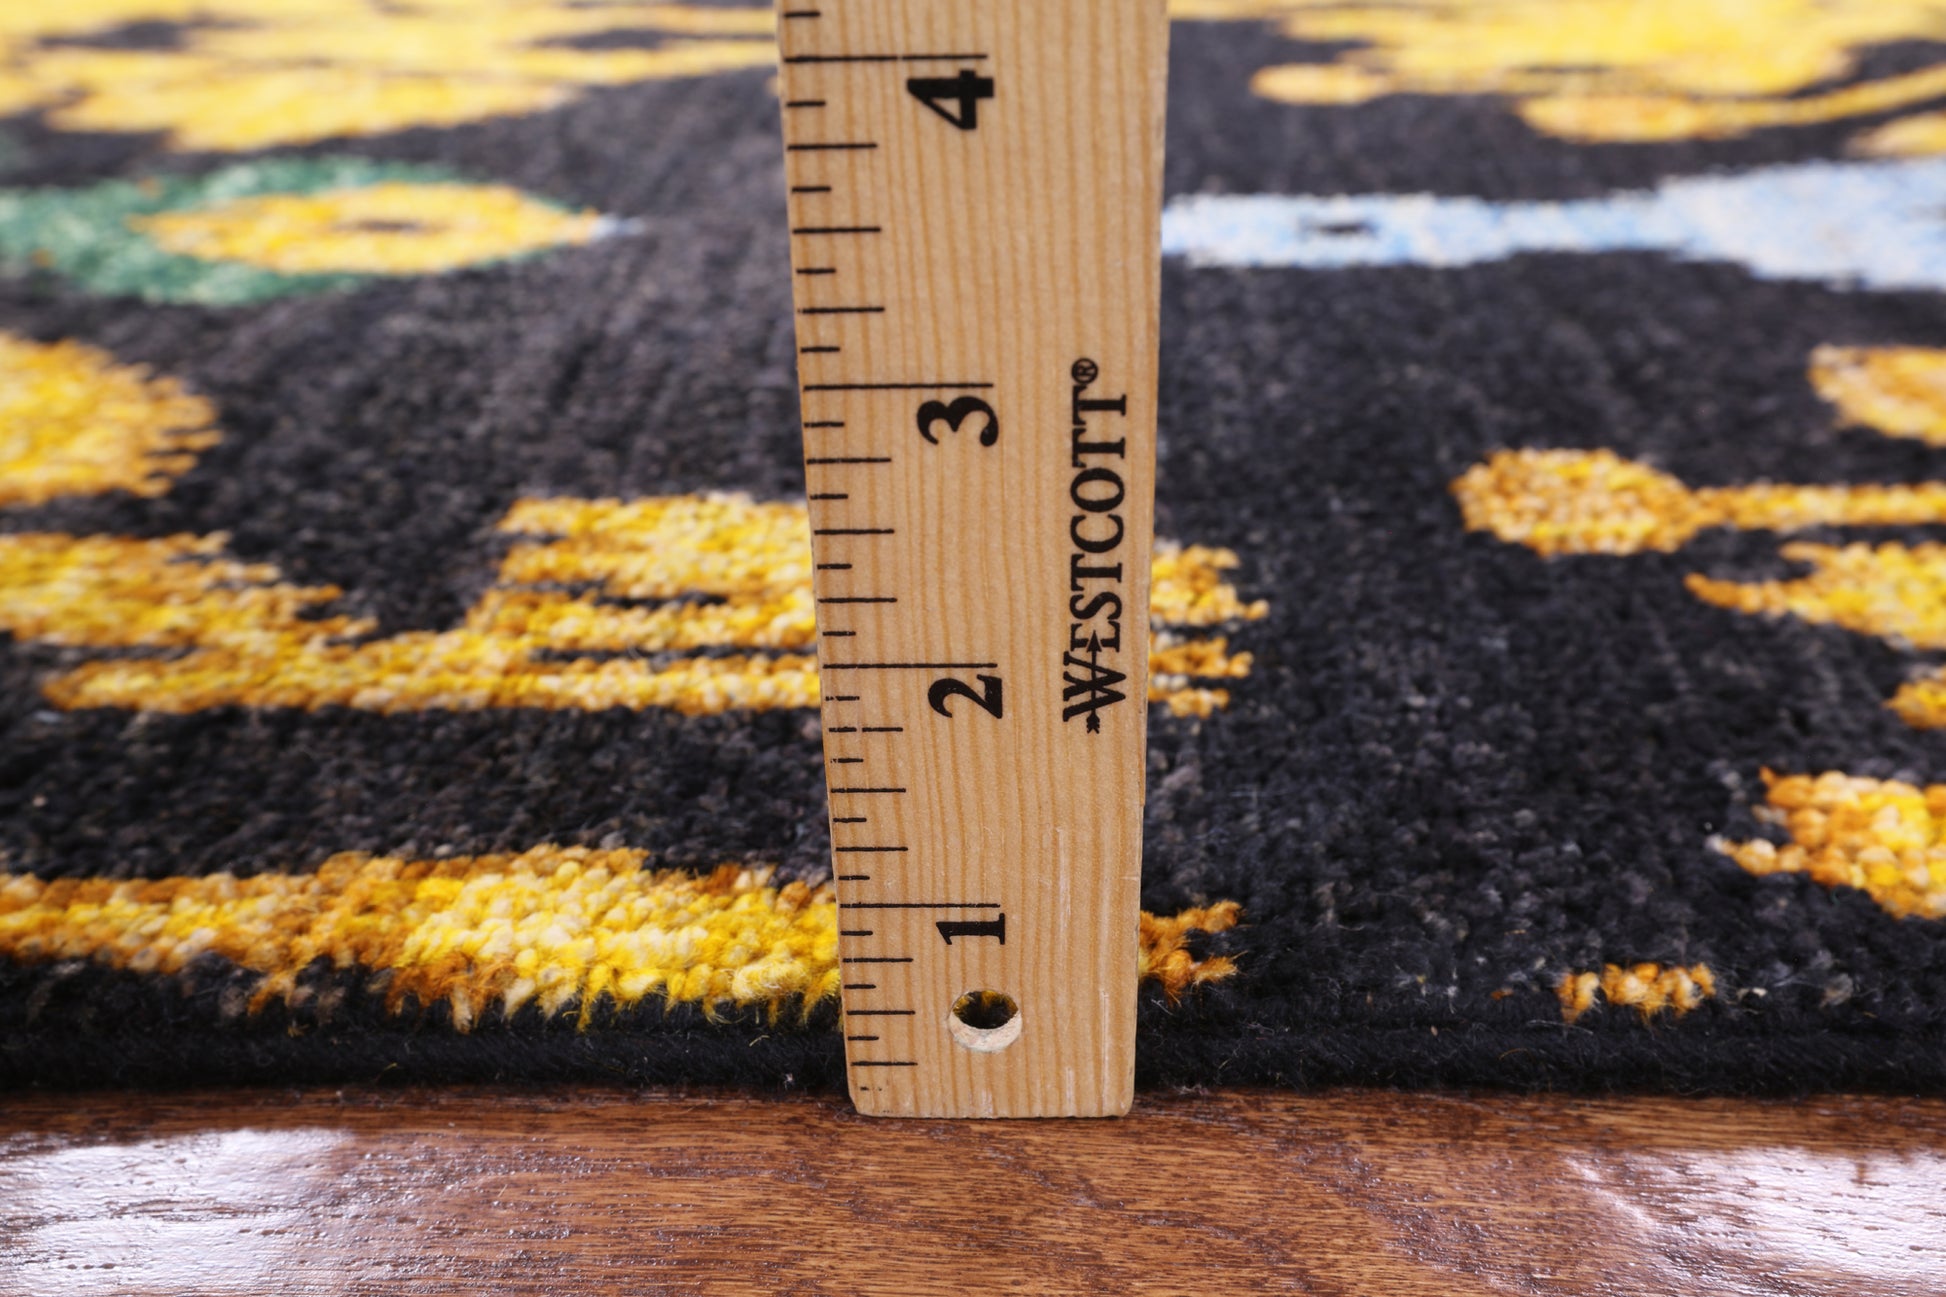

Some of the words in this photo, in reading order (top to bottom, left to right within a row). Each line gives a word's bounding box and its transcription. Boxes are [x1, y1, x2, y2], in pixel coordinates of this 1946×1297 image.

[906, 69, 994, 131] 4
[916, 395, 999, 447] 3
[928, 673, 1004, 720] 2
[935, 912, 1006, 946] 1
